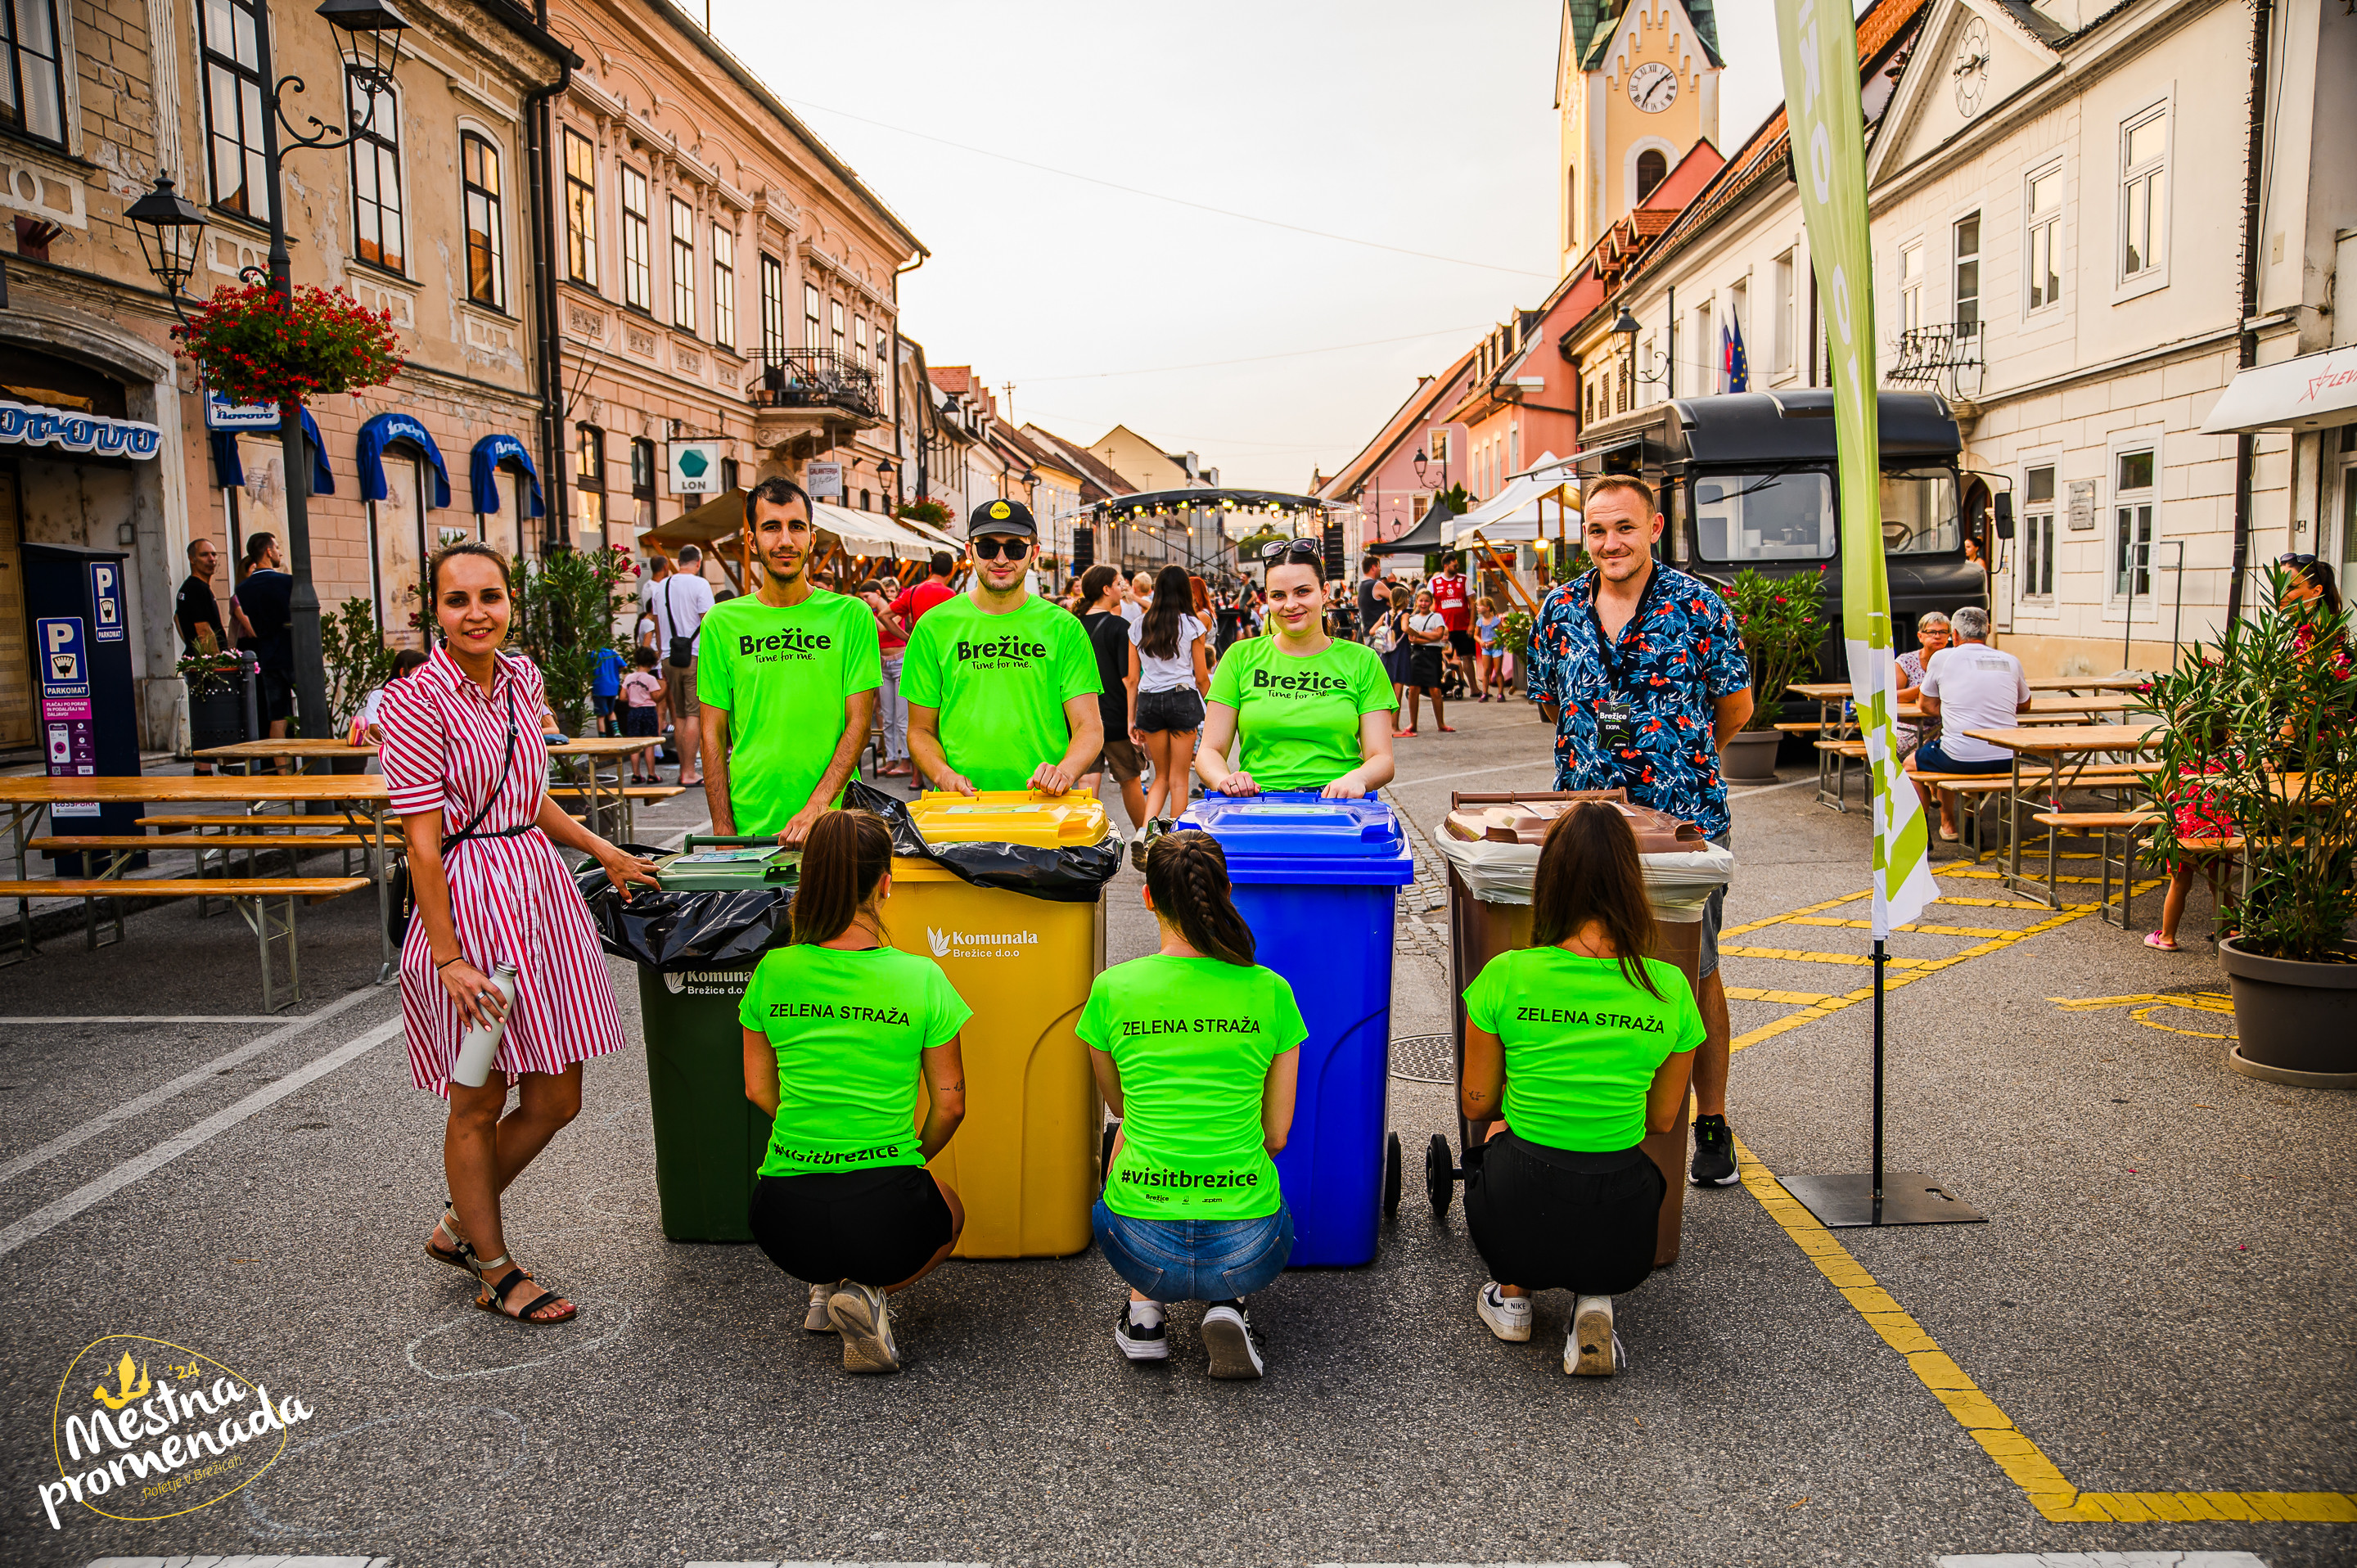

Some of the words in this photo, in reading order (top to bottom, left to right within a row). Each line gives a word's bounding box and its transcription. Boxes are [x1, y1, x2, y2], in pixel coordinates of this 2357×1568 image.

[682, 481, 706, 490] LON
[96, 568, 113, 597] P
[47, 623, 74, 652] P
[98, 630, 121, 638] PARKOMAT
[739, 627, 831, 656] Brežice
[957, 635, 1047, 662] Brežice
[755, 654, 778, 664] Time
[780, 651, 794, 662] for
[796, 652, 816, 661] me.
[971, 660, 994, 670] Time
[997, 658, 1011, 669] for
[1013, 660, 1032, 669] me.
[1253, 669, 1348, 692] Brežice
[47, 687, 86, 695] PARKOMAT
[1268, 689, 1291, 699] Time
[1295, 691, 1309, 701] for
[1600, 712, 1627, 721] Brežice
[953, 930, 1039, 945] Komunala
[953, 948, 993, 957] Brežice
[995, 948, 1020, 957] d.o.o
[687, 985, 725, 994] Brežice
[769, 1003, 835, 1018] ZELENA
[840, 1006, 910, 1027] STRAŽA
[1517, 1007, 1589, 1025] ZELENA
[1595, 1012, 1665, 1034] STRAŽA
[1122, 1019, 1188, 1035] ZELENA
[1193, 1016, 1260, 1034] STRAŽA
[1121, 1166, 1258, 1187] #visitbrezice
[1146, 1193, 1169, 1201] Brežice
